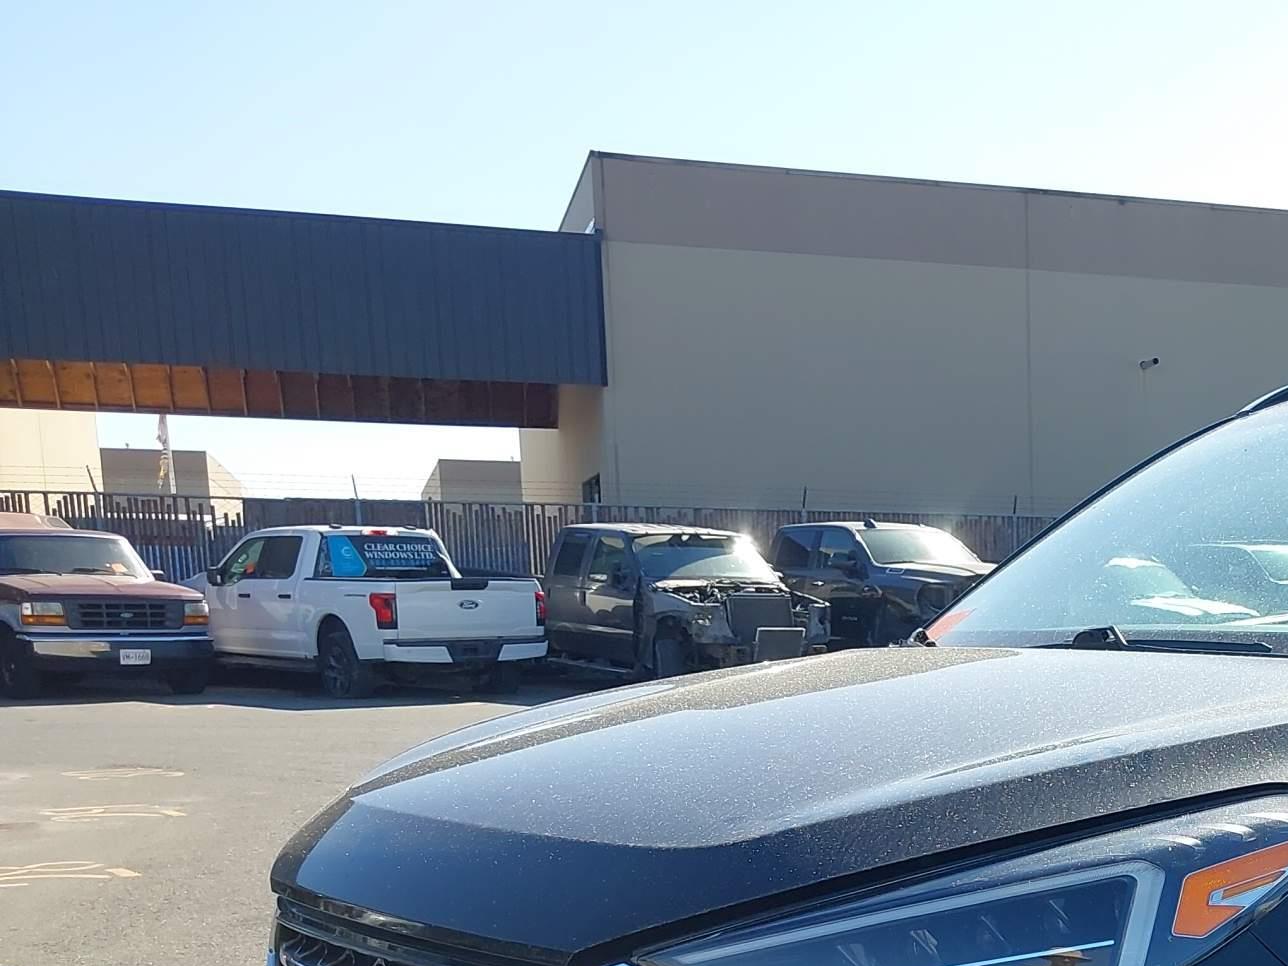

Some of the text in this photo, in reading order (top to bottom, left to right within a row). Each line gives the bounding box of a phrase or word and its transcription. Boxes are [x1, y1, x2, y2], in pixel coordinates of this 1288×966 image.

[364, 543, 434, 552] CLEAR CHOICE
[364, 551, 436, 560] WINDOWS LTD.
